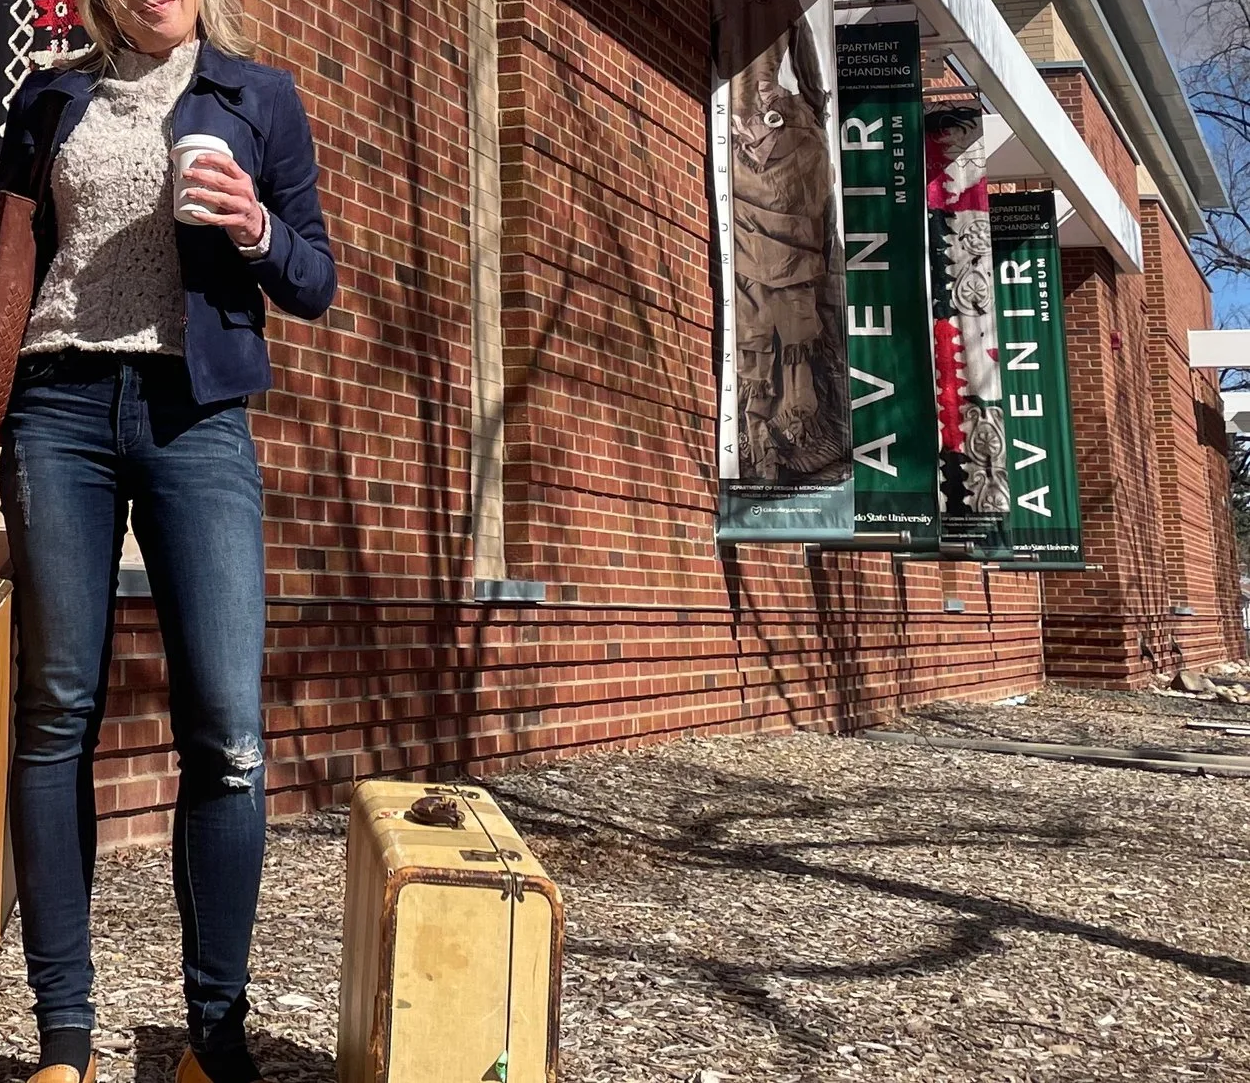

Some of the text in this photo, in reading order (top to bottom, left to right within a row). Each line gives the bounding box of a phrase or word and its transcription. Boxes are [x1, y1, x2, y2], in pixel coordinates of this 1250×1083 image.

[837, 41, 899, 53] EPARTMENT
[837, 65, 911, 77] CHANDISING
[838, 54, 899, 65] F DESIGN &
[716, 104, 729, 264] MUSEUM
[892, 115, 907, 204] MUSEUM
[841, 117, 898, 478] AVENIR
[1036, 258, 1050, 322] MUSEUM
[1000, 259, 1052, 518] AVENIR
[867, 513, 887, 523] State
[888, 513, 933, 526] University
